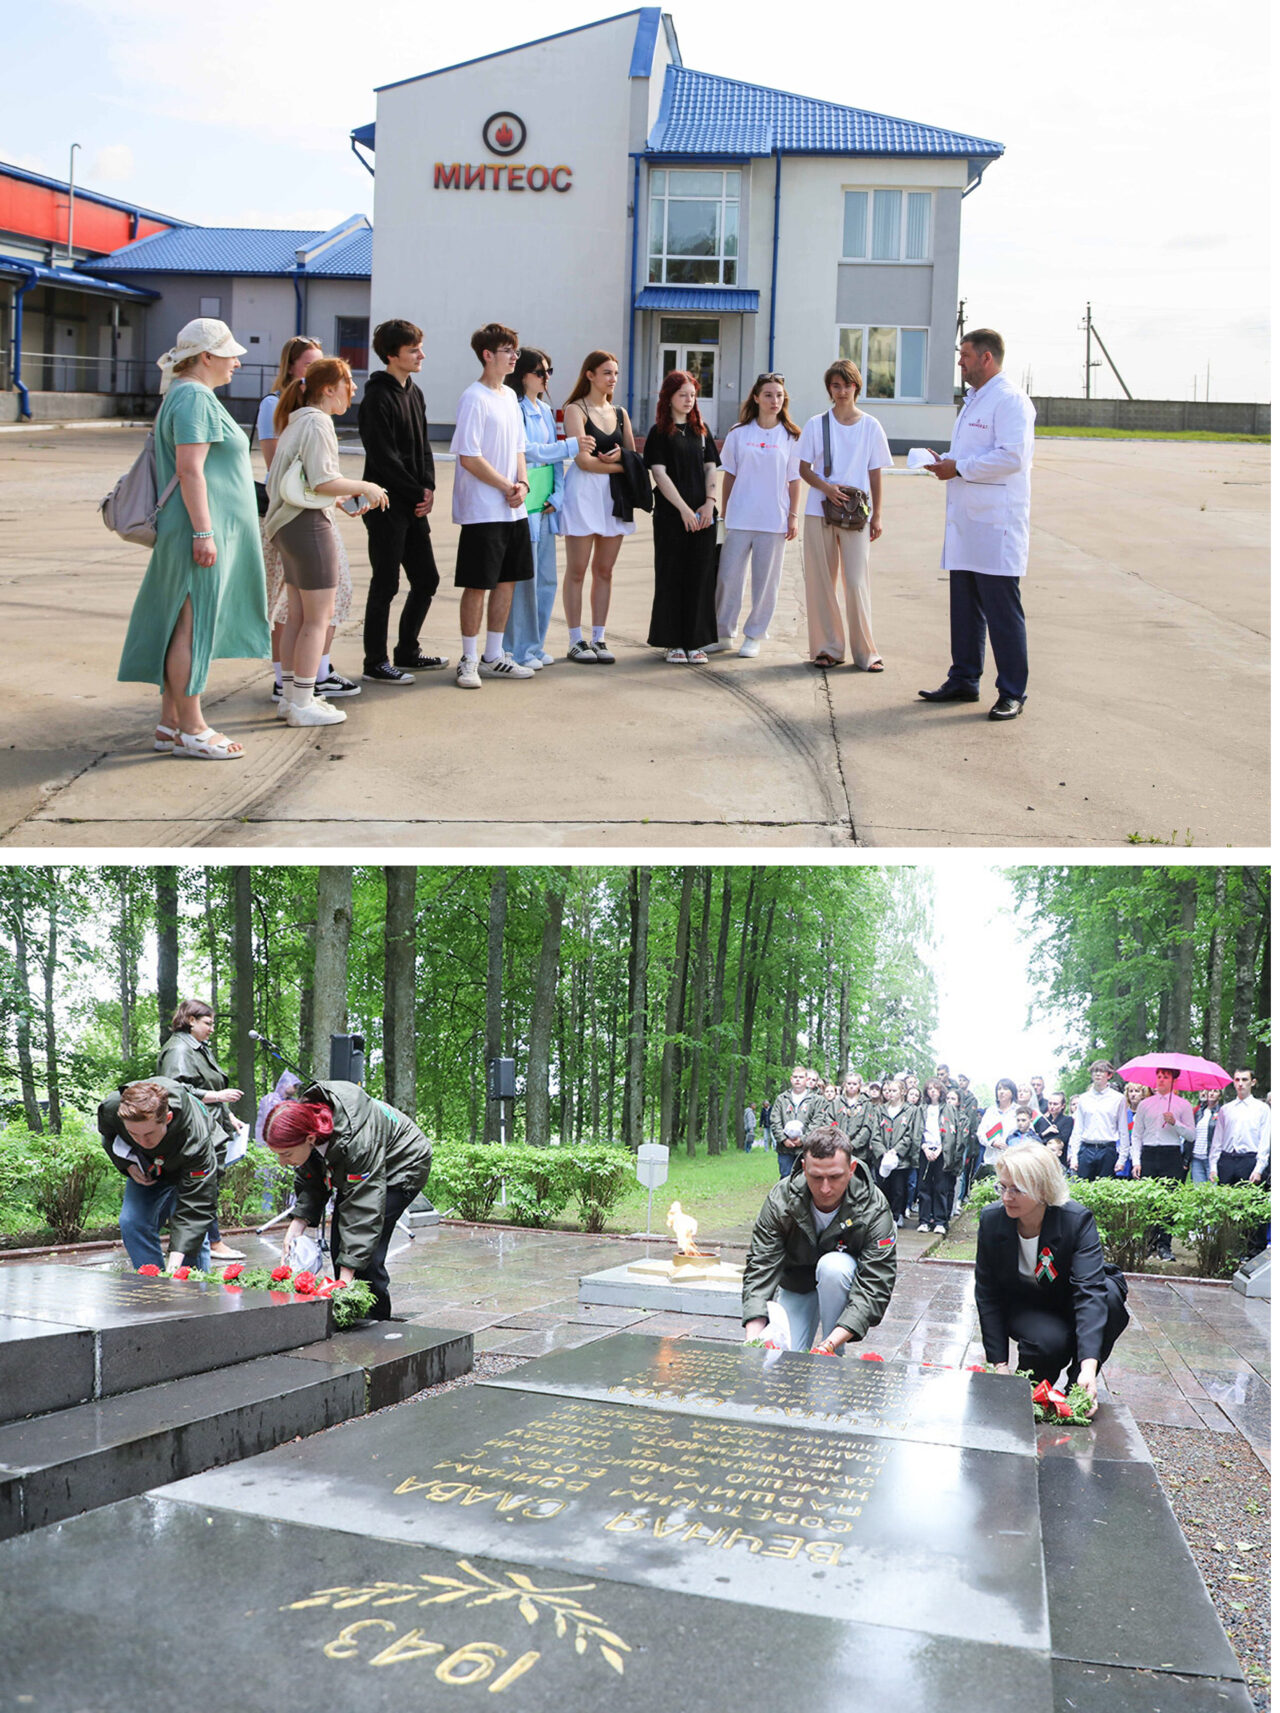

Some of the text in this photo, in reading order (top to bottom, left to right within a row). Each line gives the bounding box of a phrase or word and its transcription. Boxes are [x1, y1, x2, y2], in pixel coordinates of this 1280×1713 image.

[434, 162, 572, 192] МИТЕОС
[460, 1449, 863, 1518] ПАВШИМ В БОЯХ С
[630, 1447, 661, 1457] ЗА
[631, 1435, 842, 1471] НЕЗАВИСИМОСТЬ
[392, 1476, 847, 1566] ВЕЧНАЯ СЛАВА
[432, 1459, 853, 1534] СОВЕТСКИМ ВОИНАМ
[323, 1618, 541, 1693] 1943
